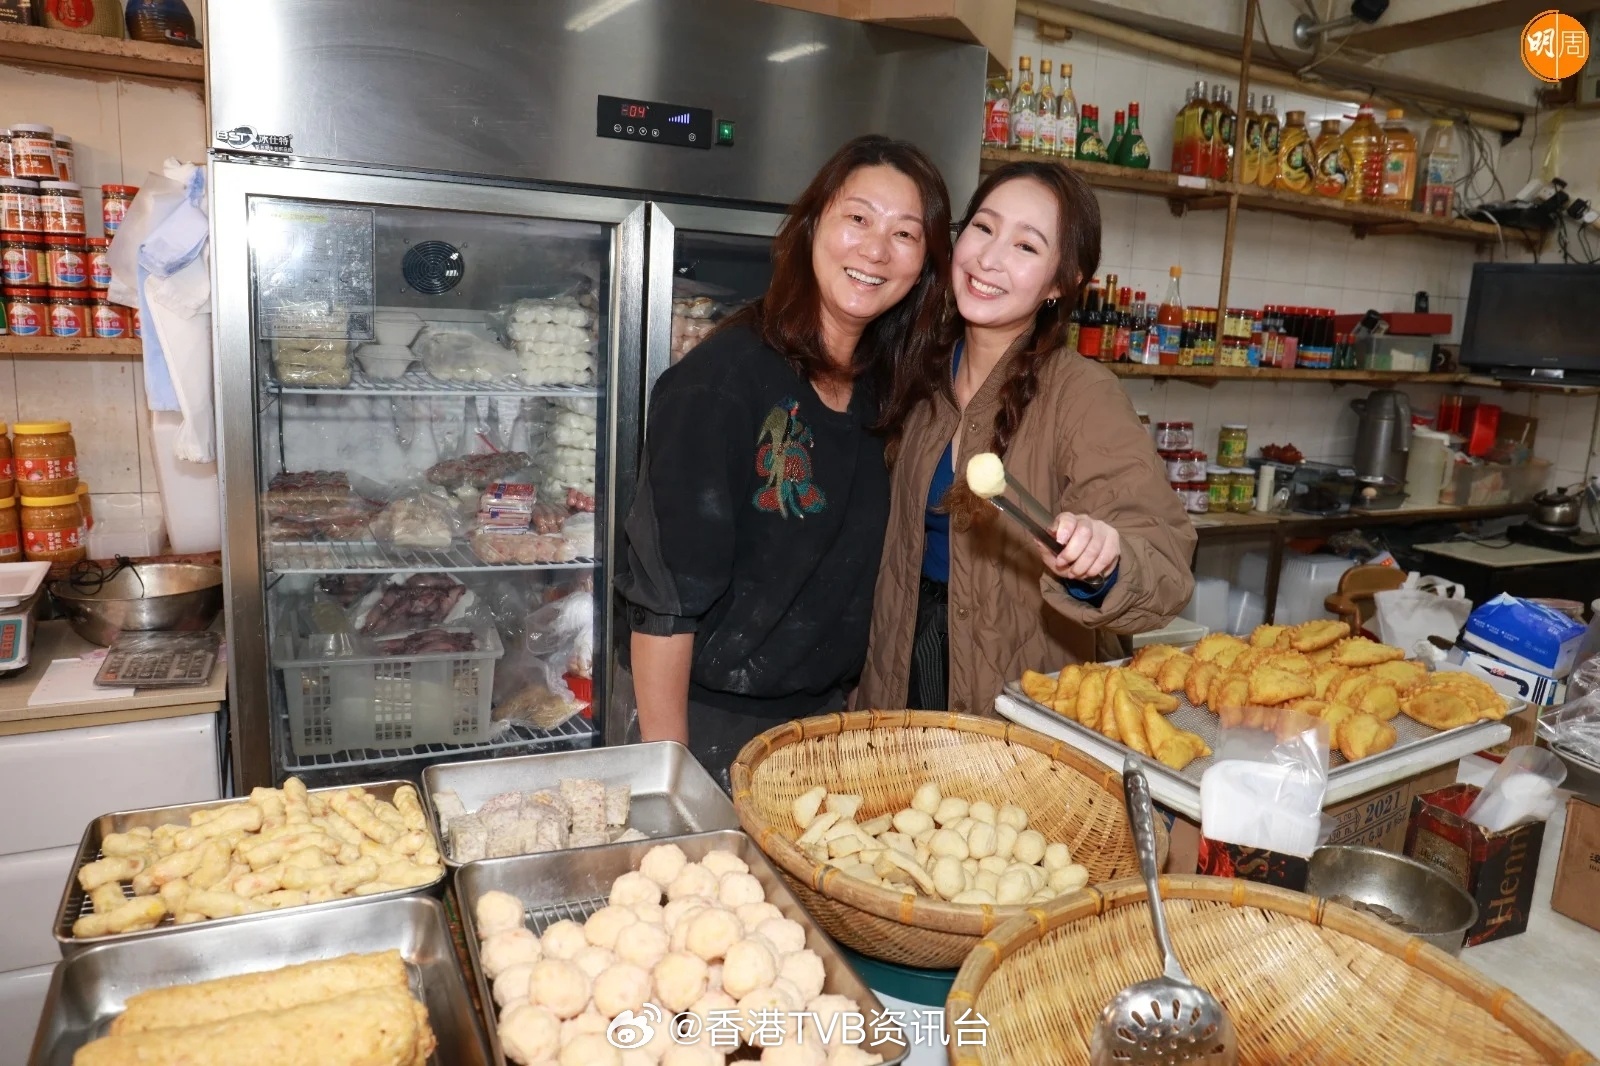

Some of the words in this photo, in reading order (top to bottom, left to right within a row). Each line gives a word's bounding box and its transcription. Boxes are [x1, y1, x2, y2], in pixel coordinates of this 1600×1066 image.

[259, 135, 289, 146] 冰仕特
[1365, 791, 1400, 824] 2021
